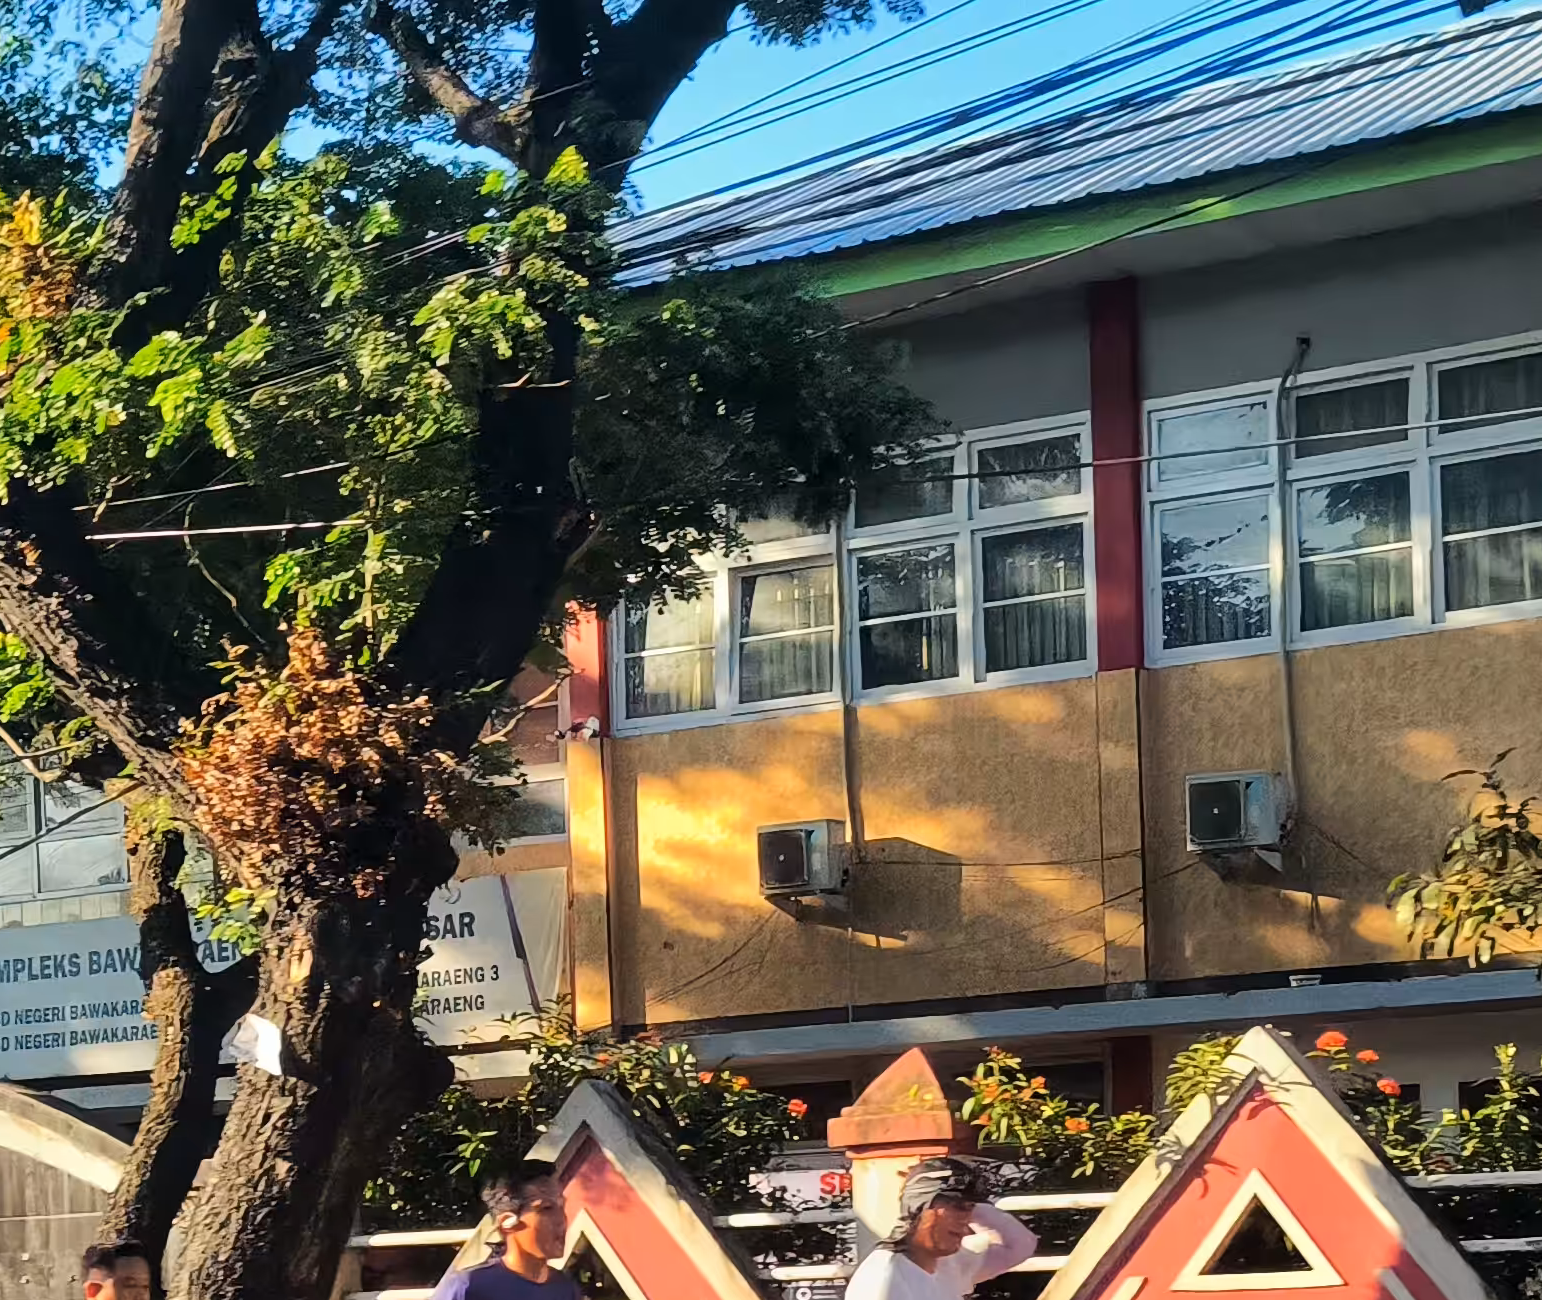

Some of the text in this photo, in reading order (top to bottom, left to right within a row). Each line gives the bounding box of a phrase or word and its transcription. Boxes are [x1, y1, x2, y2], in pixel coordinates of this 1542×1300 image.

[425, 911, 476, 941] SAR
[14, 1006, 66, 1025] NEGERI
[420, 966, 485, 988] ARAENG
[490, 965, 500, 981] 3
[14, 1032, 66, 1050] NEGERI
[70, 1024, 158, 1046] BAWAKARAE
[421, 994, 485, 1016] ARAENG
